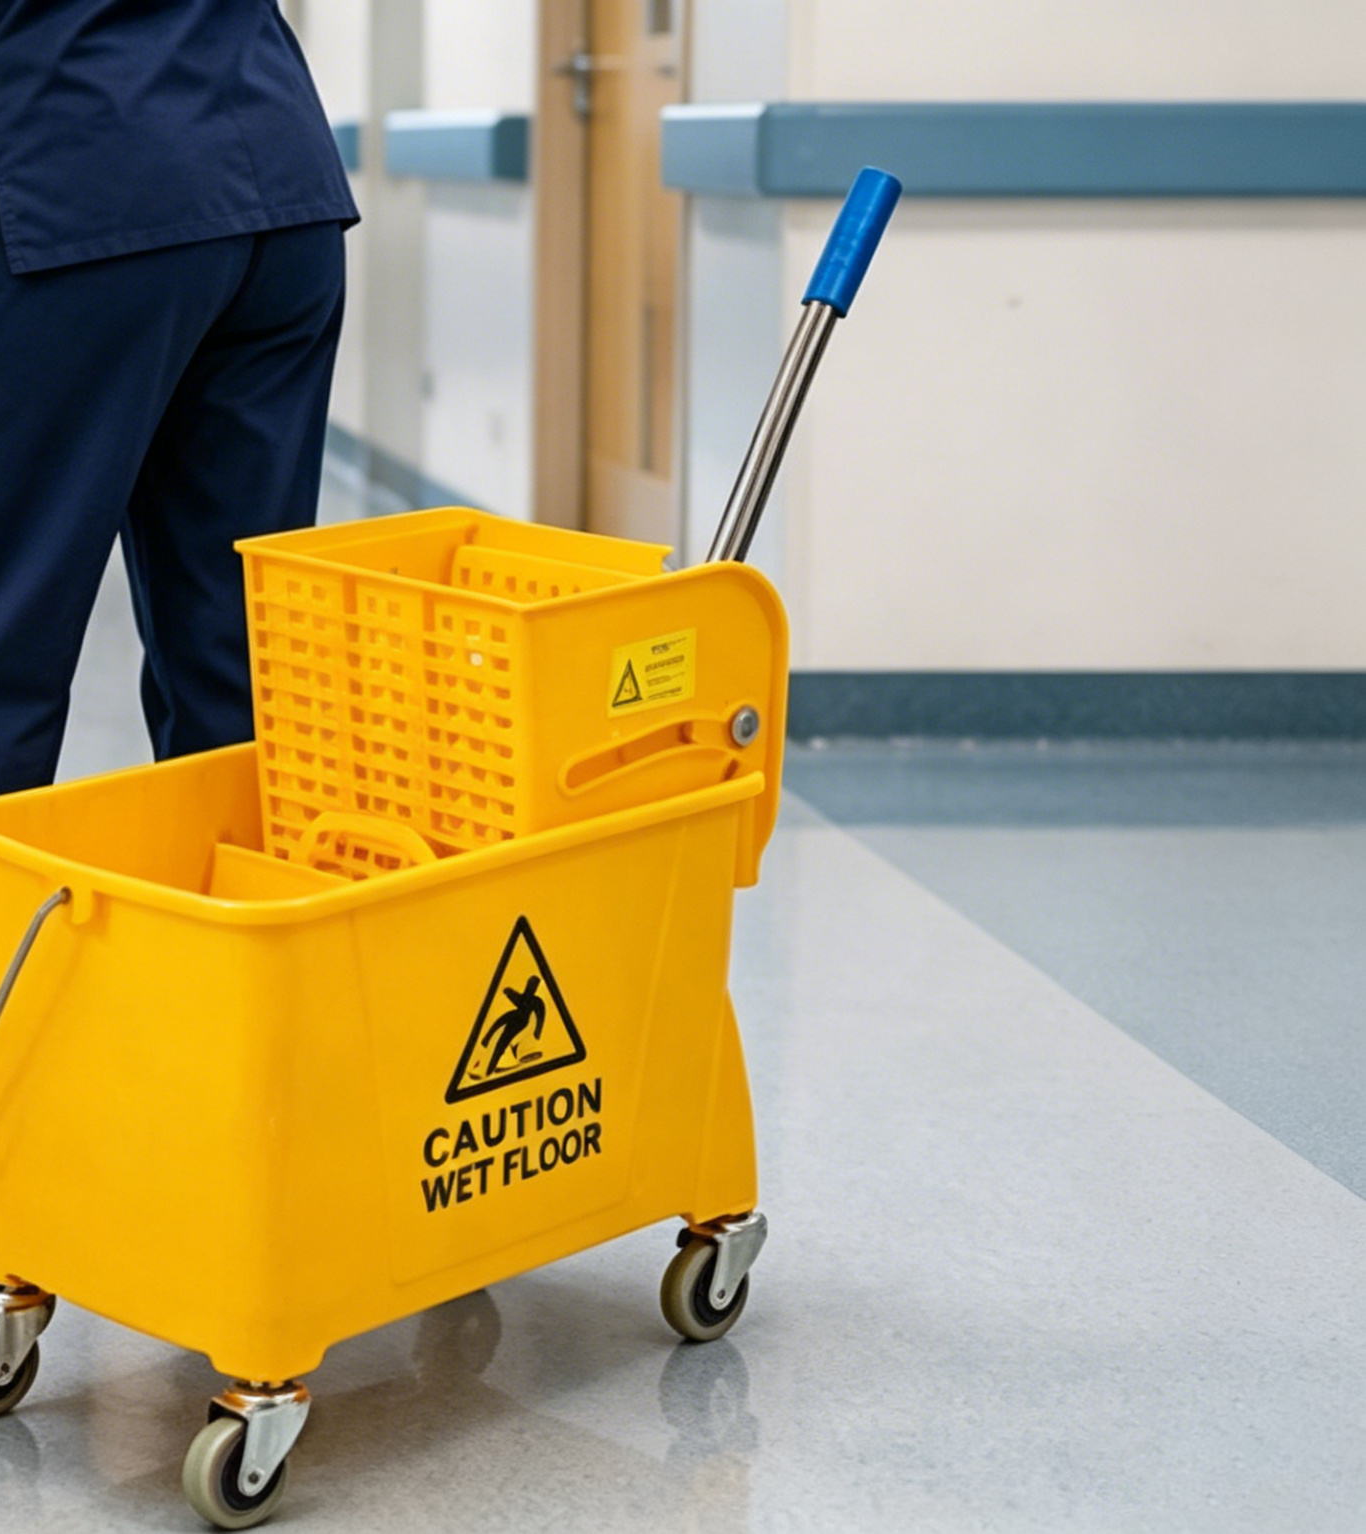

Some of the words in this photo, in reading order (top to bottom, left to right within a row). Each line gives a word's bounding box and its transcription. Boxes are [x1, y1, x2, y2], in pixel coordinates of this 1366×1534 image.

[421, 1157, 495, 1213] WET
[503, 1122, 602, 1186] FLOOR
[423, 1077, 602, 1168] CAUTION
